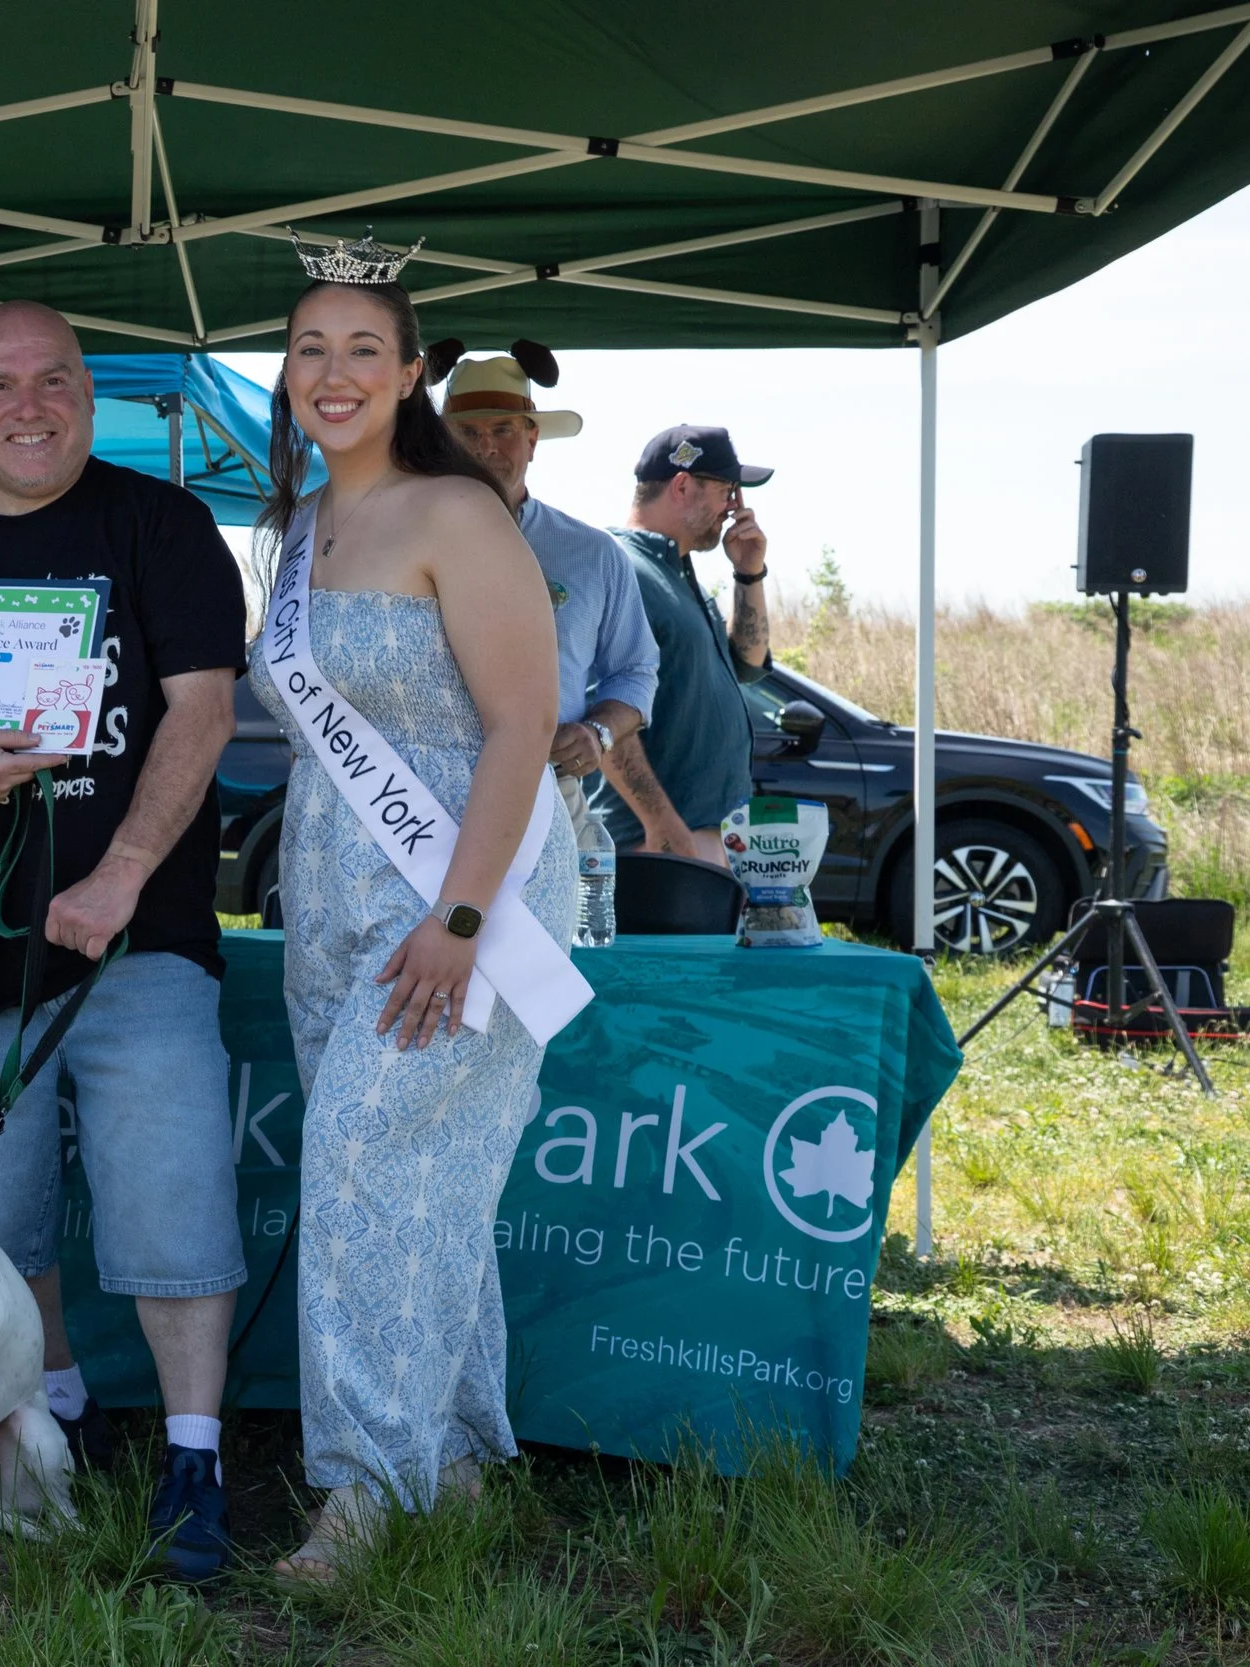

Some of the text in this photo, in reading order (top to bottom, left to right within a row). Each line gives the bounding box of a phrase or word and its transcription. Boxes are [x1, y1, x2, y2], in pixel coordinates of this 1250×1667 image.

[8, 619, 47, 630] Alliance
[13, 638, 58, 651] Award
[271, 533, 437, 857] Miss City of New York
[749, 834, 800, 850] Nutro
[741, 860, 810, 874] CRUNCHY
[493, 1211, 604, 1265] aling
[626, 1225, 704, 1272] the
[724, 1237, 866, 1300] future
[591, 1325, 853, 1404] FreshkillsPark.org
